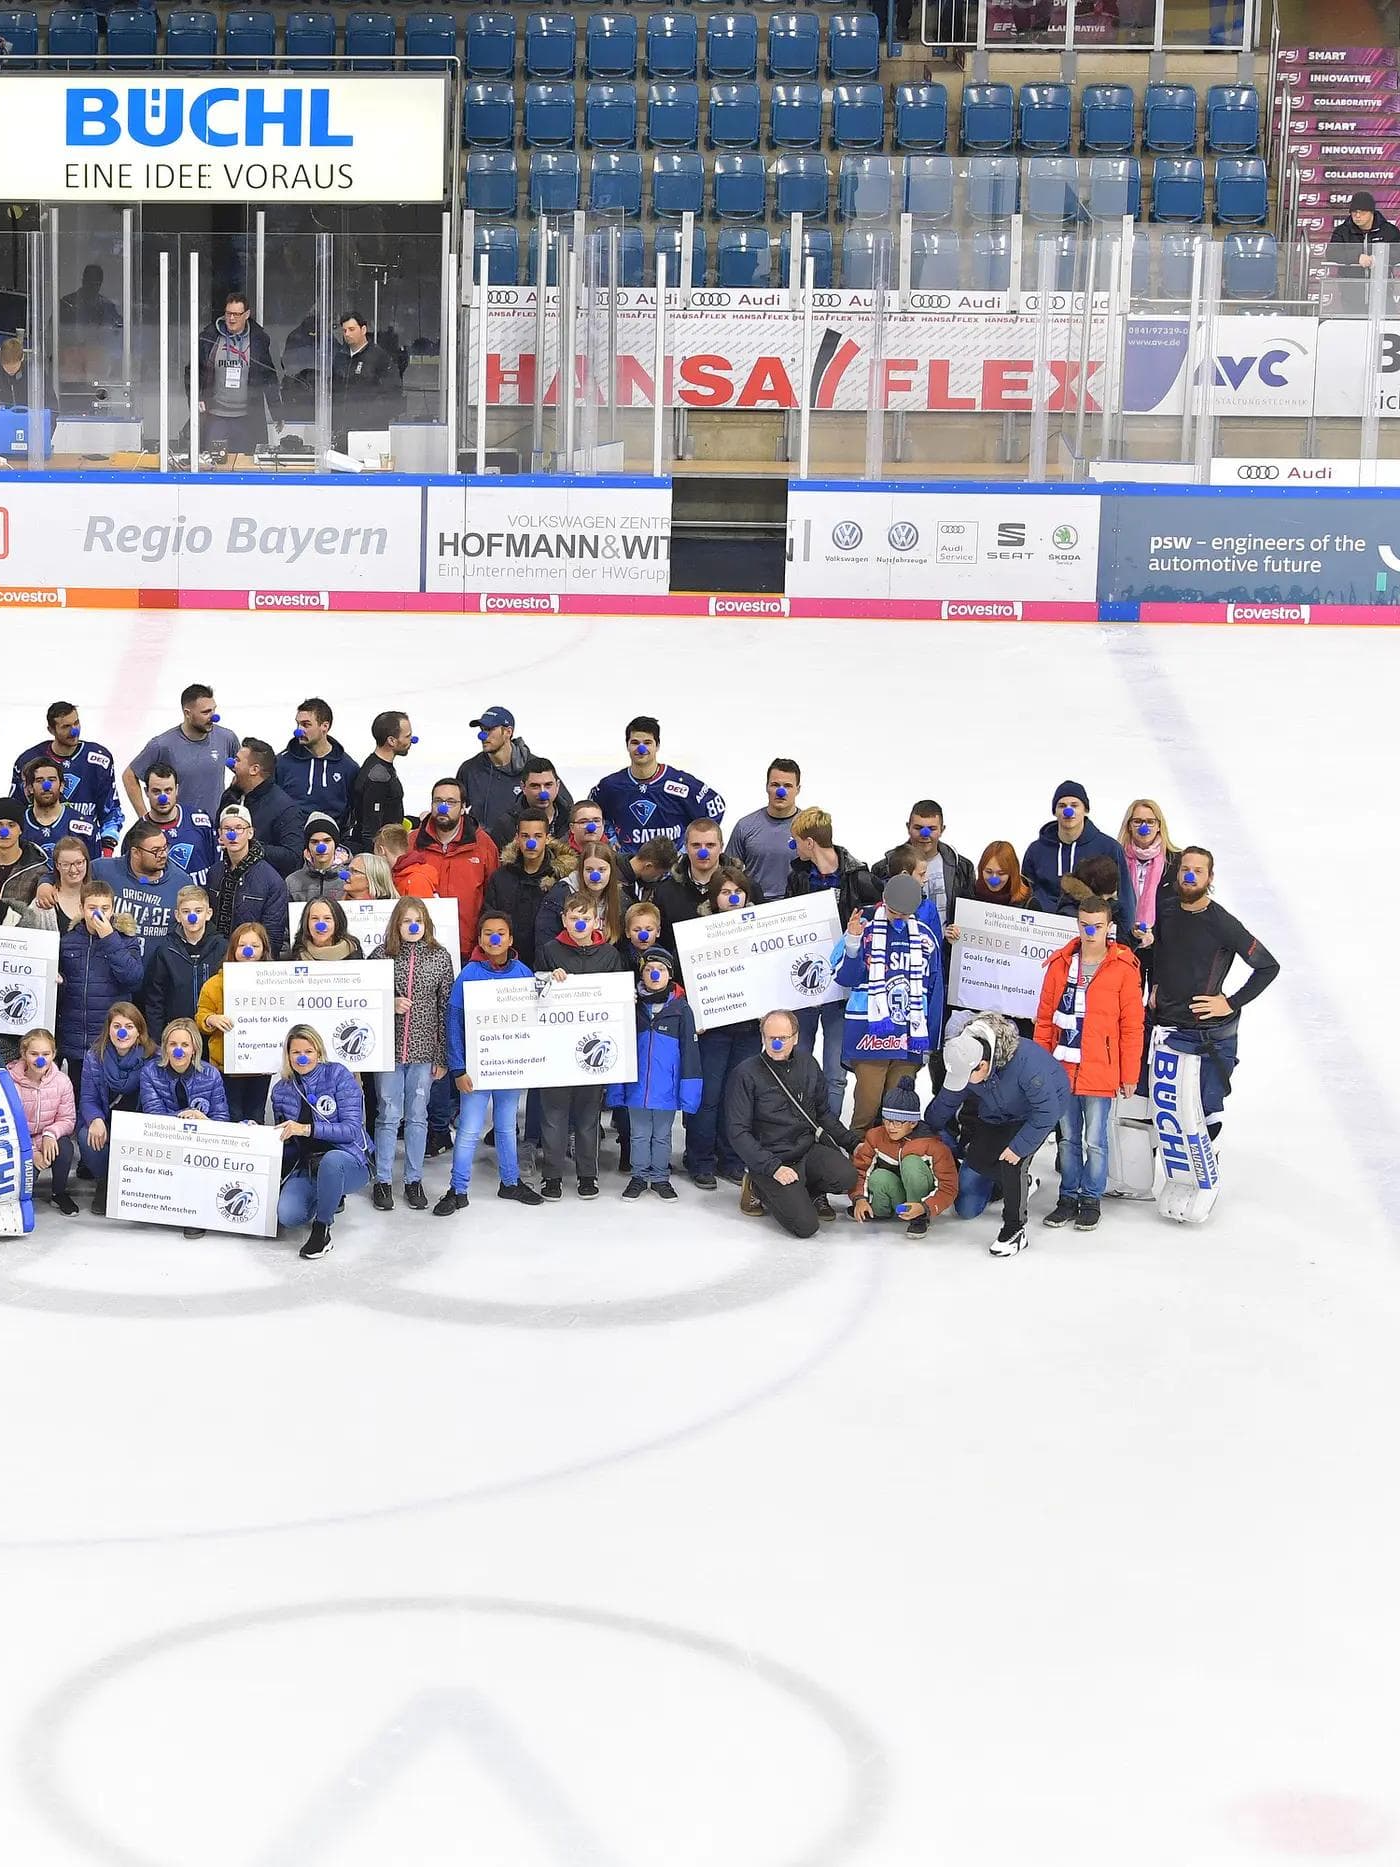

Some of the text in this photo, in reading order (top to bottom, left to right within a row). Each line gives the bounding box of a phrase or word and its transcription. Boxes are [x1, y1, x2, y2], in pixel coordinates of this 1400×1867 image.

[1308, 52, 1346, 61] SMART
[1310, 74, 1371, 83] INNOVATIVE
[1314, 98, 1382, 107] COLLABORATIVE
[66, 87, 353, 147] BÜCHL
[1318, 122, 1356, 131] SMART
[1321, 146, 1383, 155] INNOVATIVE
[65, 163, 353, 189] EINE IDEE VORAUS
[1325, 170, 1394, 180] COLLABORATIVE
[738, 294, 780, 306] Audi
[958, 296, 1001, 309] Audi
[1287, 466, 1332, 479] Audi
[507, 514, 616, 530] VOLKSWAGEN
[82, 514, 389, 565] Regio Bayern
[1150, 533, 1366, 556] psw engineers of the
[940, 545, 964, 553] Audi
[986, 551, 1035, 561] SEAT
[824, 555, 869, 565] Volkswagen
[939, 553, 974, 562] Service
[1148, 555, 1322, 573] automotive future
[438, 563, 598, 579] Ein Unternehmen der
[255, 592, 320, 607] covestro
[486, 596, 550, 610] covestro
[715, 599, 781, 613] covestro
[948, 603, 1013, 617] covestro
[1234, 606, 1301, 620] covestro
[706, 796, 725, 818] 88
[122, 887, 163, 907] ORIGINAL
[143, 926, 168, 937] BRAND
[690, 945, 739, 964] SPENDE
[787, 931, 818, 947] Euro
[962, 932, 1010, 949] SPENDE
[963, 952, 1011, 967] Goals for Kids
[2, 960, 32, 975] Euro
[696, 970, 717, 981] Goals
[730, 964, 745, 973] Kids
[961, 976, 1036, 997] Frauenhaus Ingolstadt
[234, 997, 285, 1006] SPENDE
[337, 996, 368, 1009] Euro
[726, 991, 745, 1001] Haus
[237, 1015, 289, 1024] Goals for Kids
[476, 1010, 609, 1025] SPENDE Euro
[480, 1068, 524, 1078] Marienstein
[1153, 1050, 1191, 1179] BÜCHL
[120, 1145, 255, 1173] SPENDE Euro
[122, 1164, 174, 1177] Goals for Kids
[120, 1200, 197, 1215] Besondere Menschen
